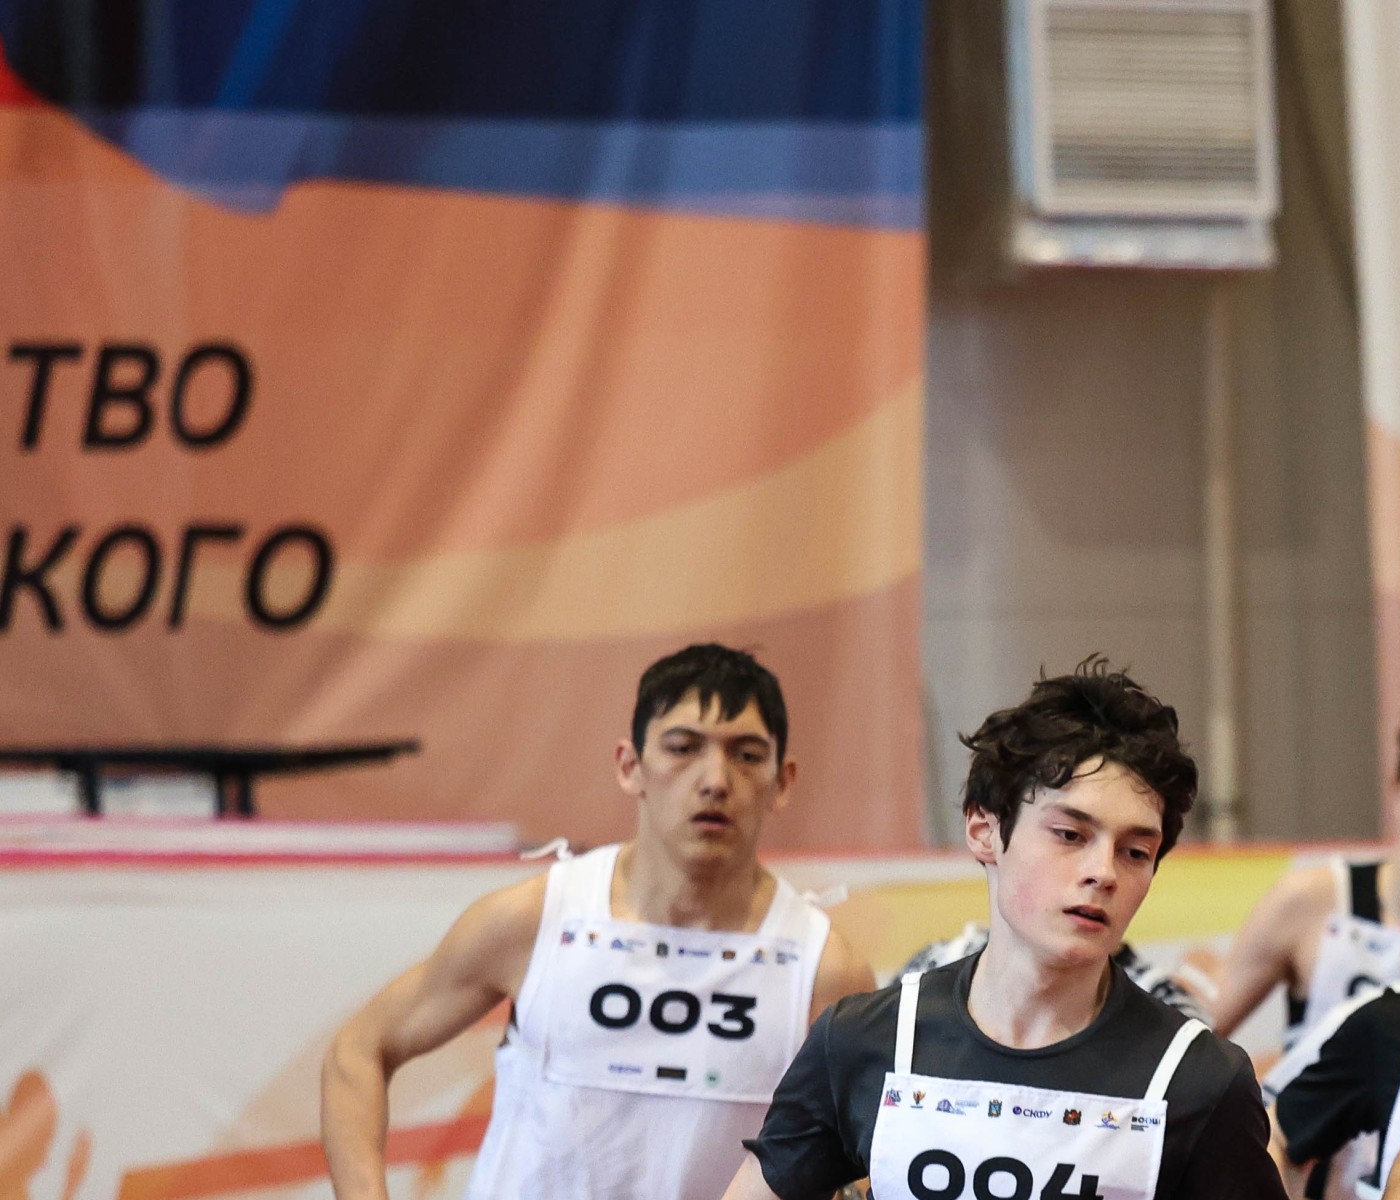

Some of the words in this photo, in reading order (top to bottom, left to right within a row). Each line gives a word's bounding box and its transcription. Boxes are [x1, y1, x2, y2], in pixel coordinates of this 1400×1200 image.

[8, 341, 254, 452] ТВО
[0, 522, 337, 634] КОГО
[589, 982, 757, 1040] 003
